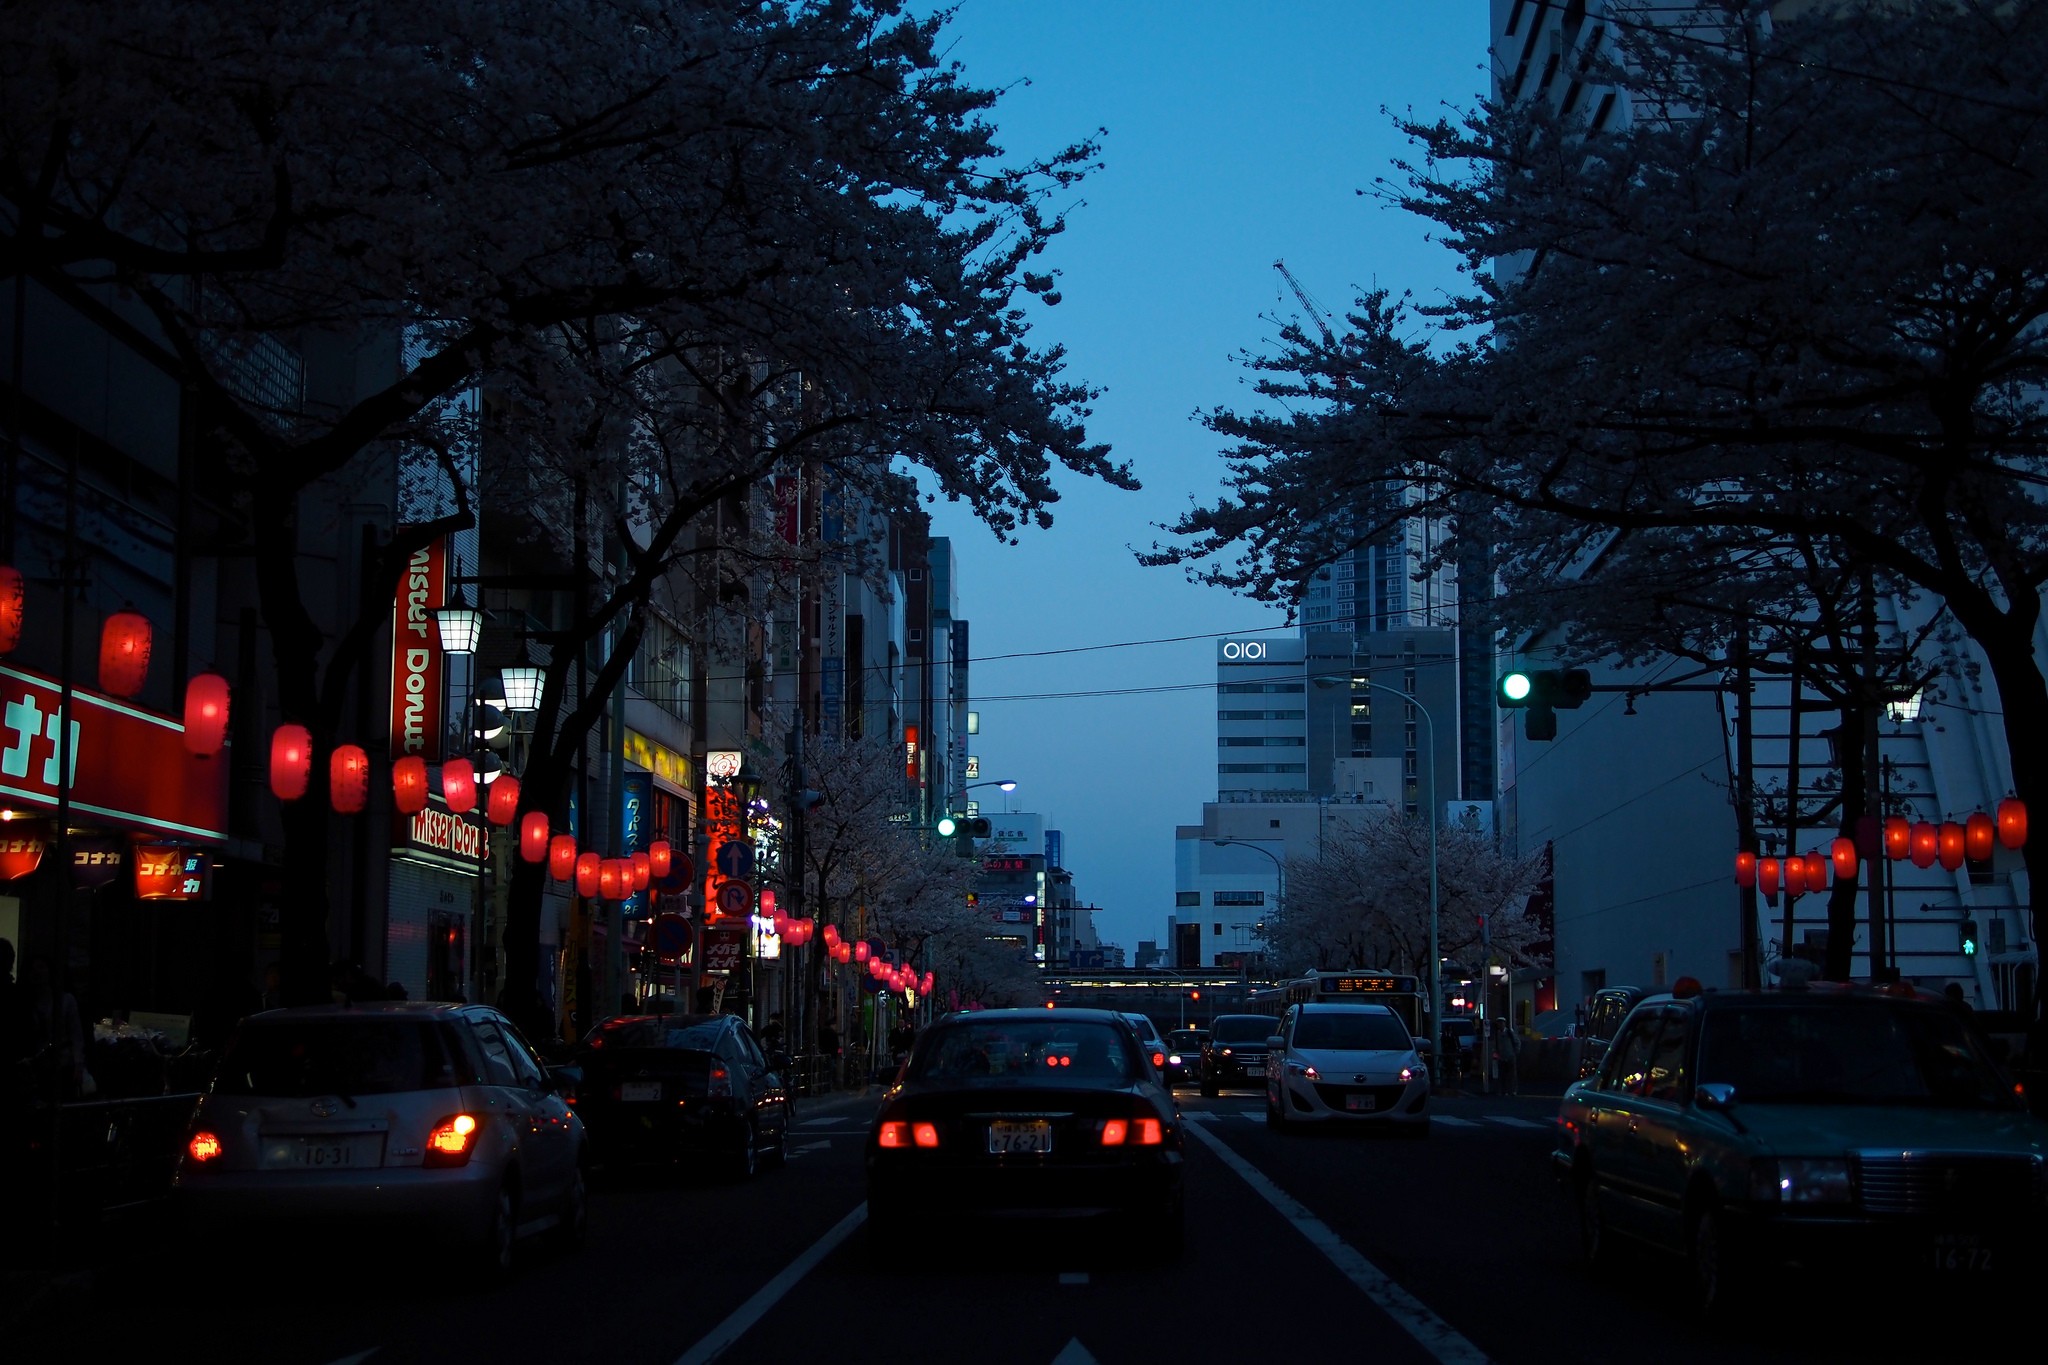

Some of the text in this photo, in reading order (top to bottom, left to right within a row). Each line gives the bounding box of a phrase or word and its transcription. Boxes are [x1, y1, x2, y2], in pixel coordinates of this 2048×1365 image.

[403, 648, 430, 754] Donut
[74, 851, 121, 866] コナカ
[139, 862, 184, 876] コナカ
[305, 1146, 351, 1166] 10-31
[1934, 1246, 1994, 1273] 16-72
